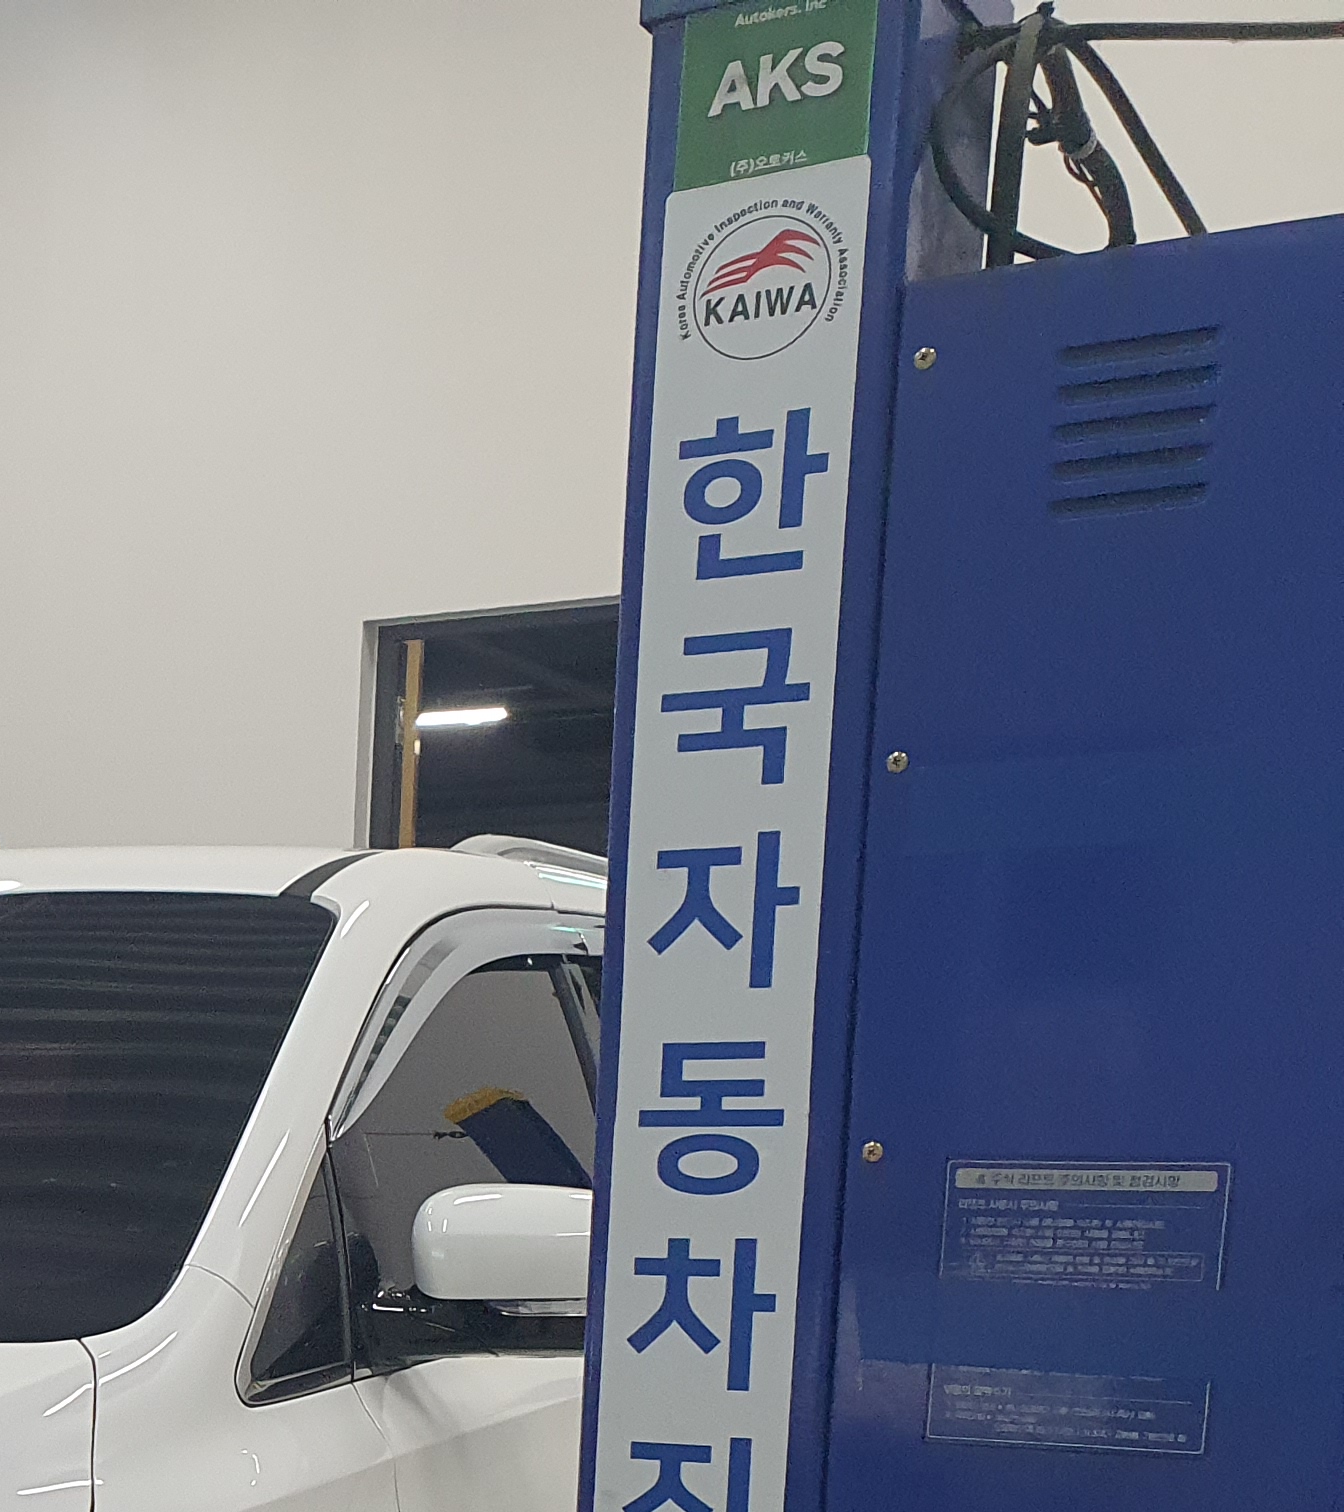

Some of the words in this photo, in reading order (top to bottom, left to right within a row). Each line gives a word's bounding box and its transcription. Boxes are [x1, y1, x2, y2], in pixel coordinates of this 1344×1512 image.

[707, 41, 845, 117] AKS
[714, 199, 779, 233] Inspection
[781, 199, 805, 211] and
[805, 203, 844, 245] Warranty
[676, 233, 715, 300] Automotive
[824, 248, 849, 323] Association
[703, 282, 818, 327] KAIWA
